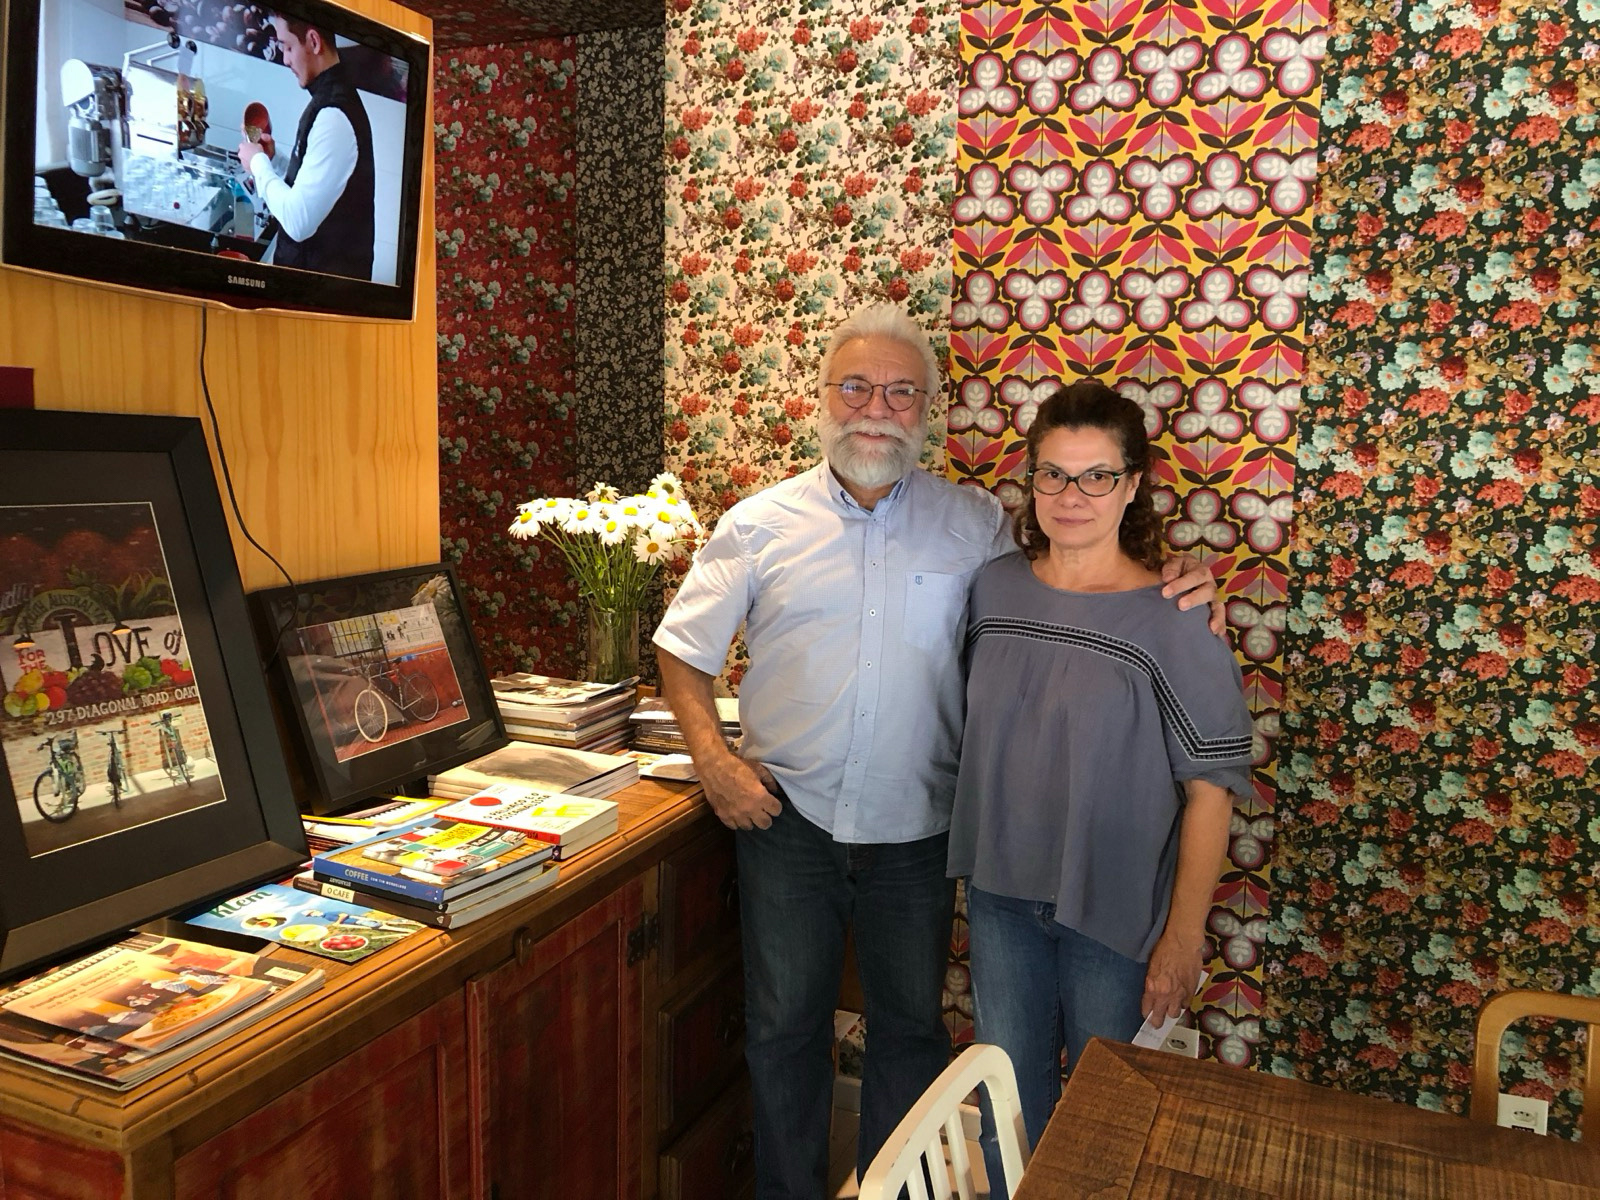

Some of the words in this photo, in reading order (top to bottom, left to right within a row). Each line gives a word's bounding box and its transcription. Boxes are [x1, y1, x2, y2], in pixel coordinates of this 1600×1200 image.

[227, 274, 266, 289] SAMSUNG
[55, 614, 160, 672] LOVE
[47, 708, 72, 726] 297
[142, 691, 169, 708] ROAD
[344, 868, 369, 882] COFFEE
[326, 887, 333, 895] O
